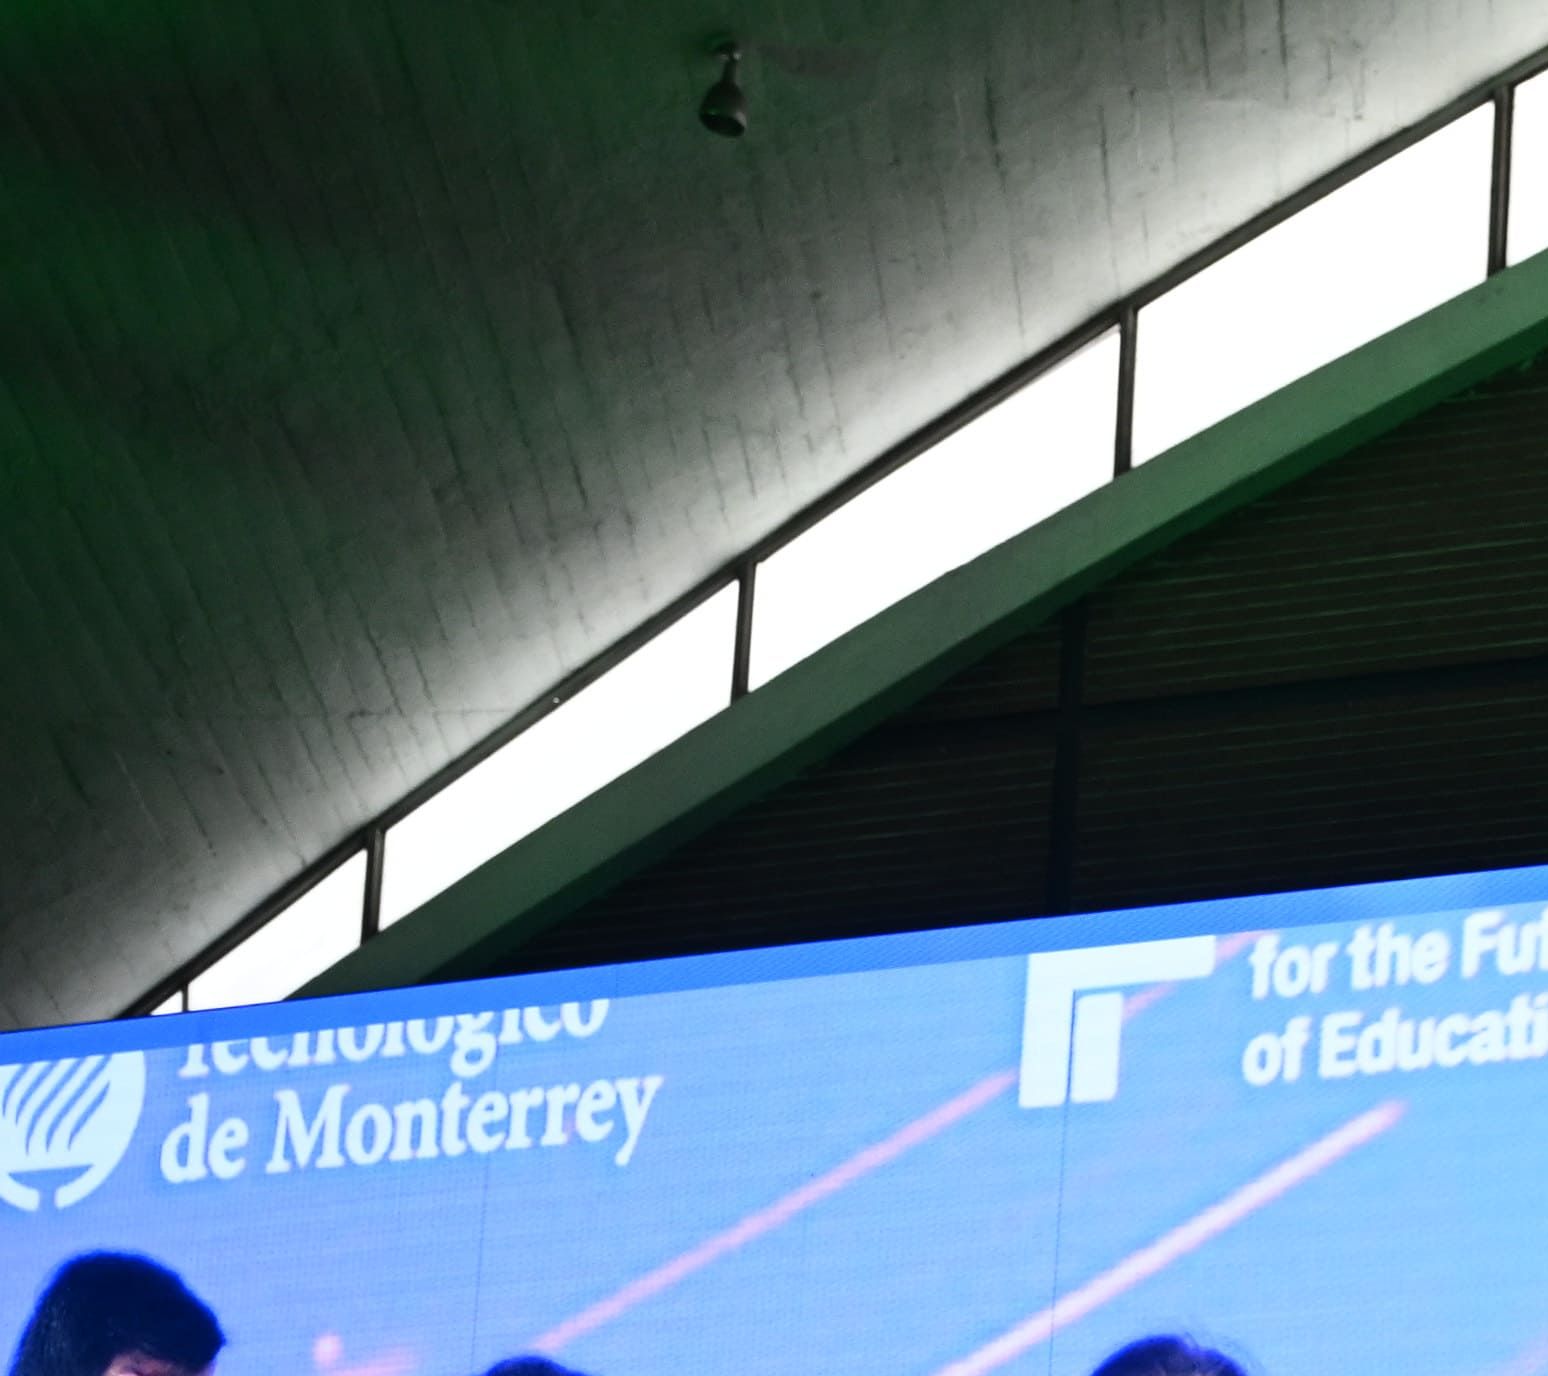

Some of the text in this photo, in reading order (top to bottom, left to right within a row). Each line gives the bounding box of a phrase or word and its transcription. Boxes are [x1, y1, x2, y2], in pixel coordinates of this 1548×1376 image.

[1247, 932, 1340, 1001] for
[1345, 922, 1452, 990] the
[1241, 1015, 1312, 1087] of
[159, 1074, 666, 1184] de Monterrey
